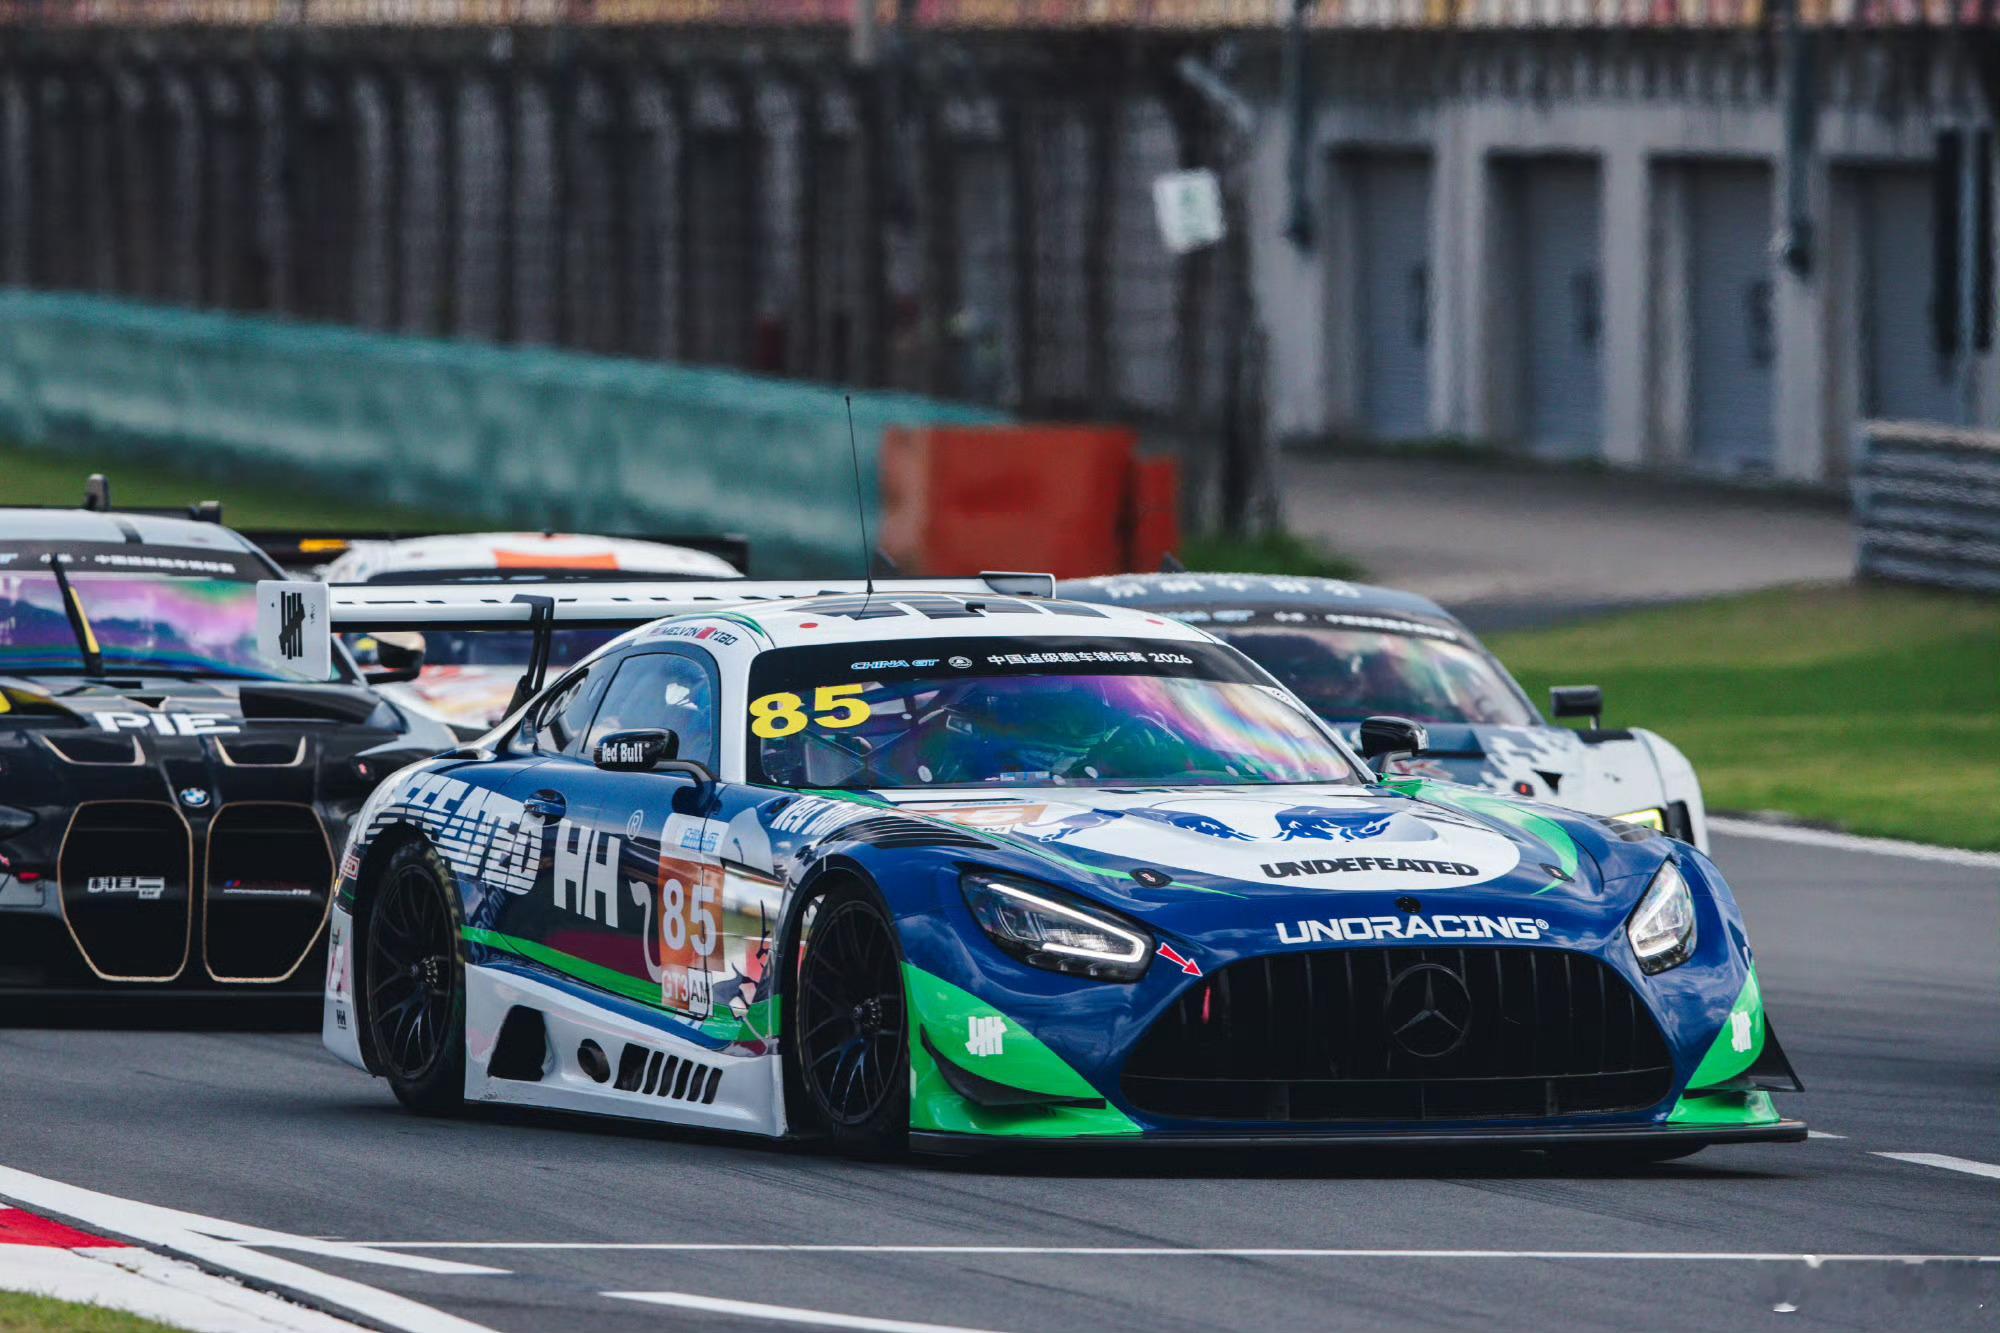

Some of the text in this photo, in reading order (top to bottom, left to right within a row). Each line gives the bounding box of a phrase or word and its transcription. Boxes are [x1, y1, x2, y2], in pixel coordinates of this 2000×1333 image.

[850, 658, 940, 670] CHINA GT
[1148, 652, 1194, 665] 2026
[93, 711, 241, 736] PIE
[748, 683, 871, 739] 85
[601, 742, 618, 763] Red
[553, 817, 622, 929] HH
[1260, 856, 1480, 879] UNDEFEATED
[662, 878, 717, 957] 85
[662, 970, 689, 1002] GT3
